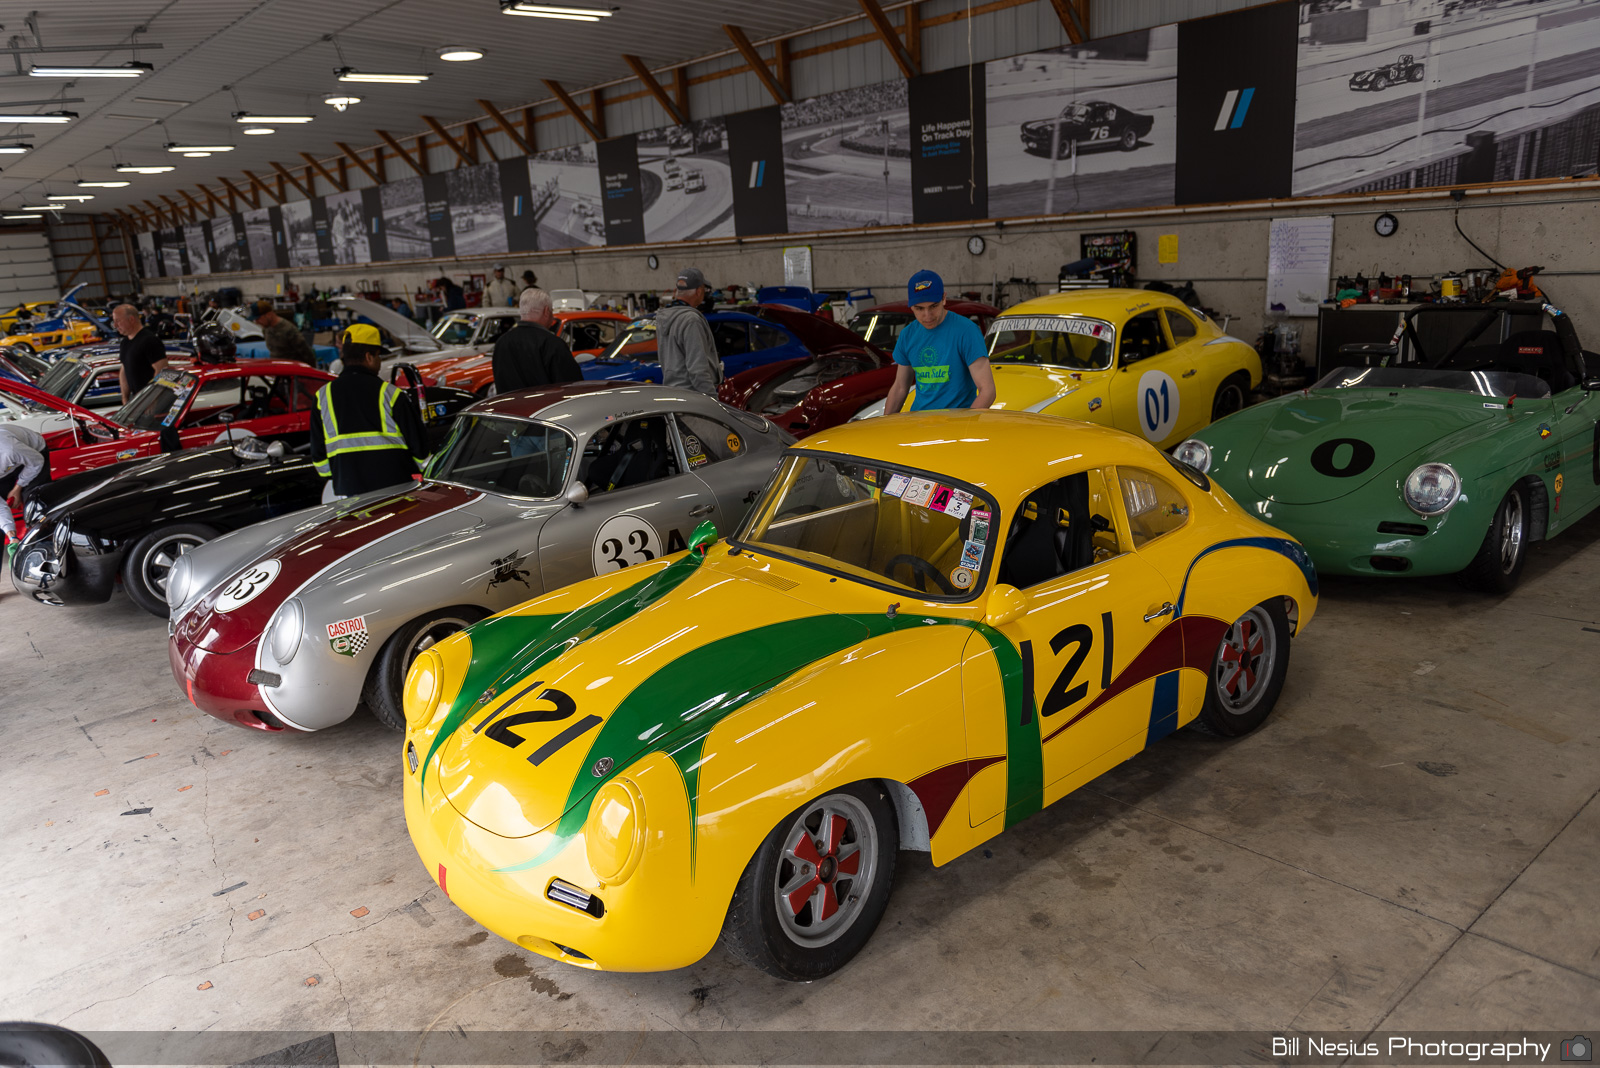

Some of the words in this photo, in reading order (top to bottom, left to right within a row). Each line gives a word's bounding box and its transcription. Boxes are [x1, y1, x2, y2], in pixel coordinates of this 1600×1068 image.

[922, 124, 935, 133] Life
[936, 120, 970, 131] Happens
[1090, 126, 1109, 140] 76
[922, 134, 933, 142] On
[934, 131, 955, 141] Track
[993, 318, 1035, 331] STAIRWAY
[1035, 318, 1094, 336] PARTNERS
[1145, 379, 1169, 431] 01
[728, 438, 739, 448] 76
[1555, 477, 1562, 489] 76
[934, 490, 950, 507] A
[601, 530, 655, 570] 33
[223, 568, 270, 601] 33
[957, 572, 967, 582] G
[328, 617, 366, 638] CASTROL
[1019, 611, 1114, 727] 121
[472, 681, 604, 767] 121
